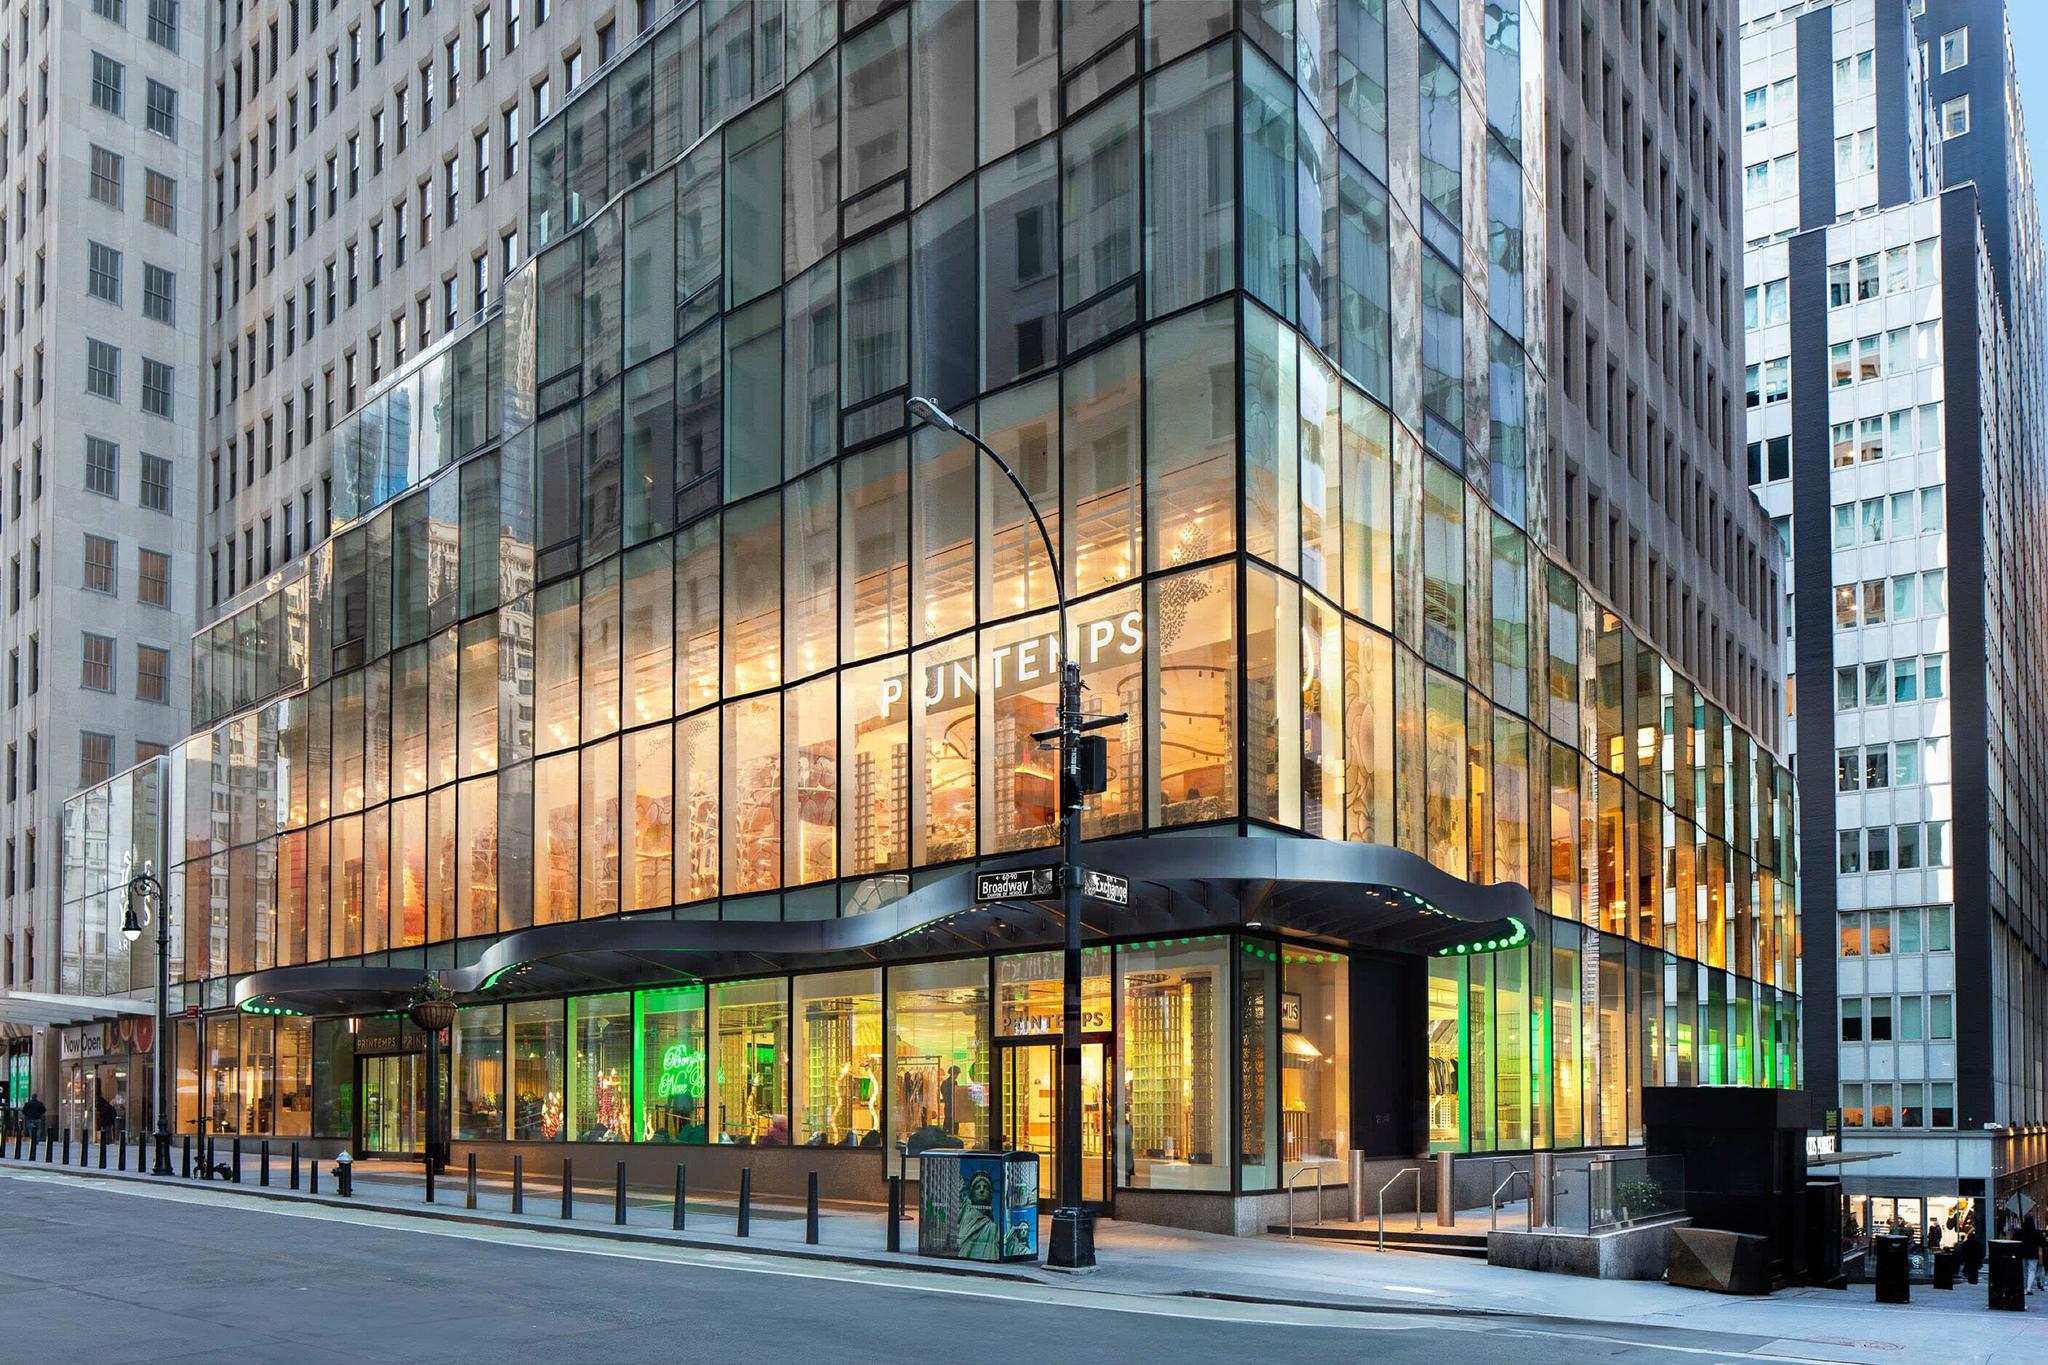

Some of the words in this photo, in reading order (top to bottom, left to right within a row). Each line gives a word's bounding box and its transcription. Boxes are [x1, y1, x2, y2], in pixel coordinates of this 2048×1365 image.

[881, 611, 1143, 719] PINTEPS
[982, 880, 1029, 894] Broadway
[1095, 877, 1127, 901] Exchange
[1003, 1012, 1104, 1031] PRINTEPS
[64, 1035, 80, 1053] Now
[81, 1033, 101, 1055] Open
[357, 1037, 396, 1049] PRINTEMPS
[664, 1044, 706, 1072] Bonjou
[658, 1070, 688, 1097] New
